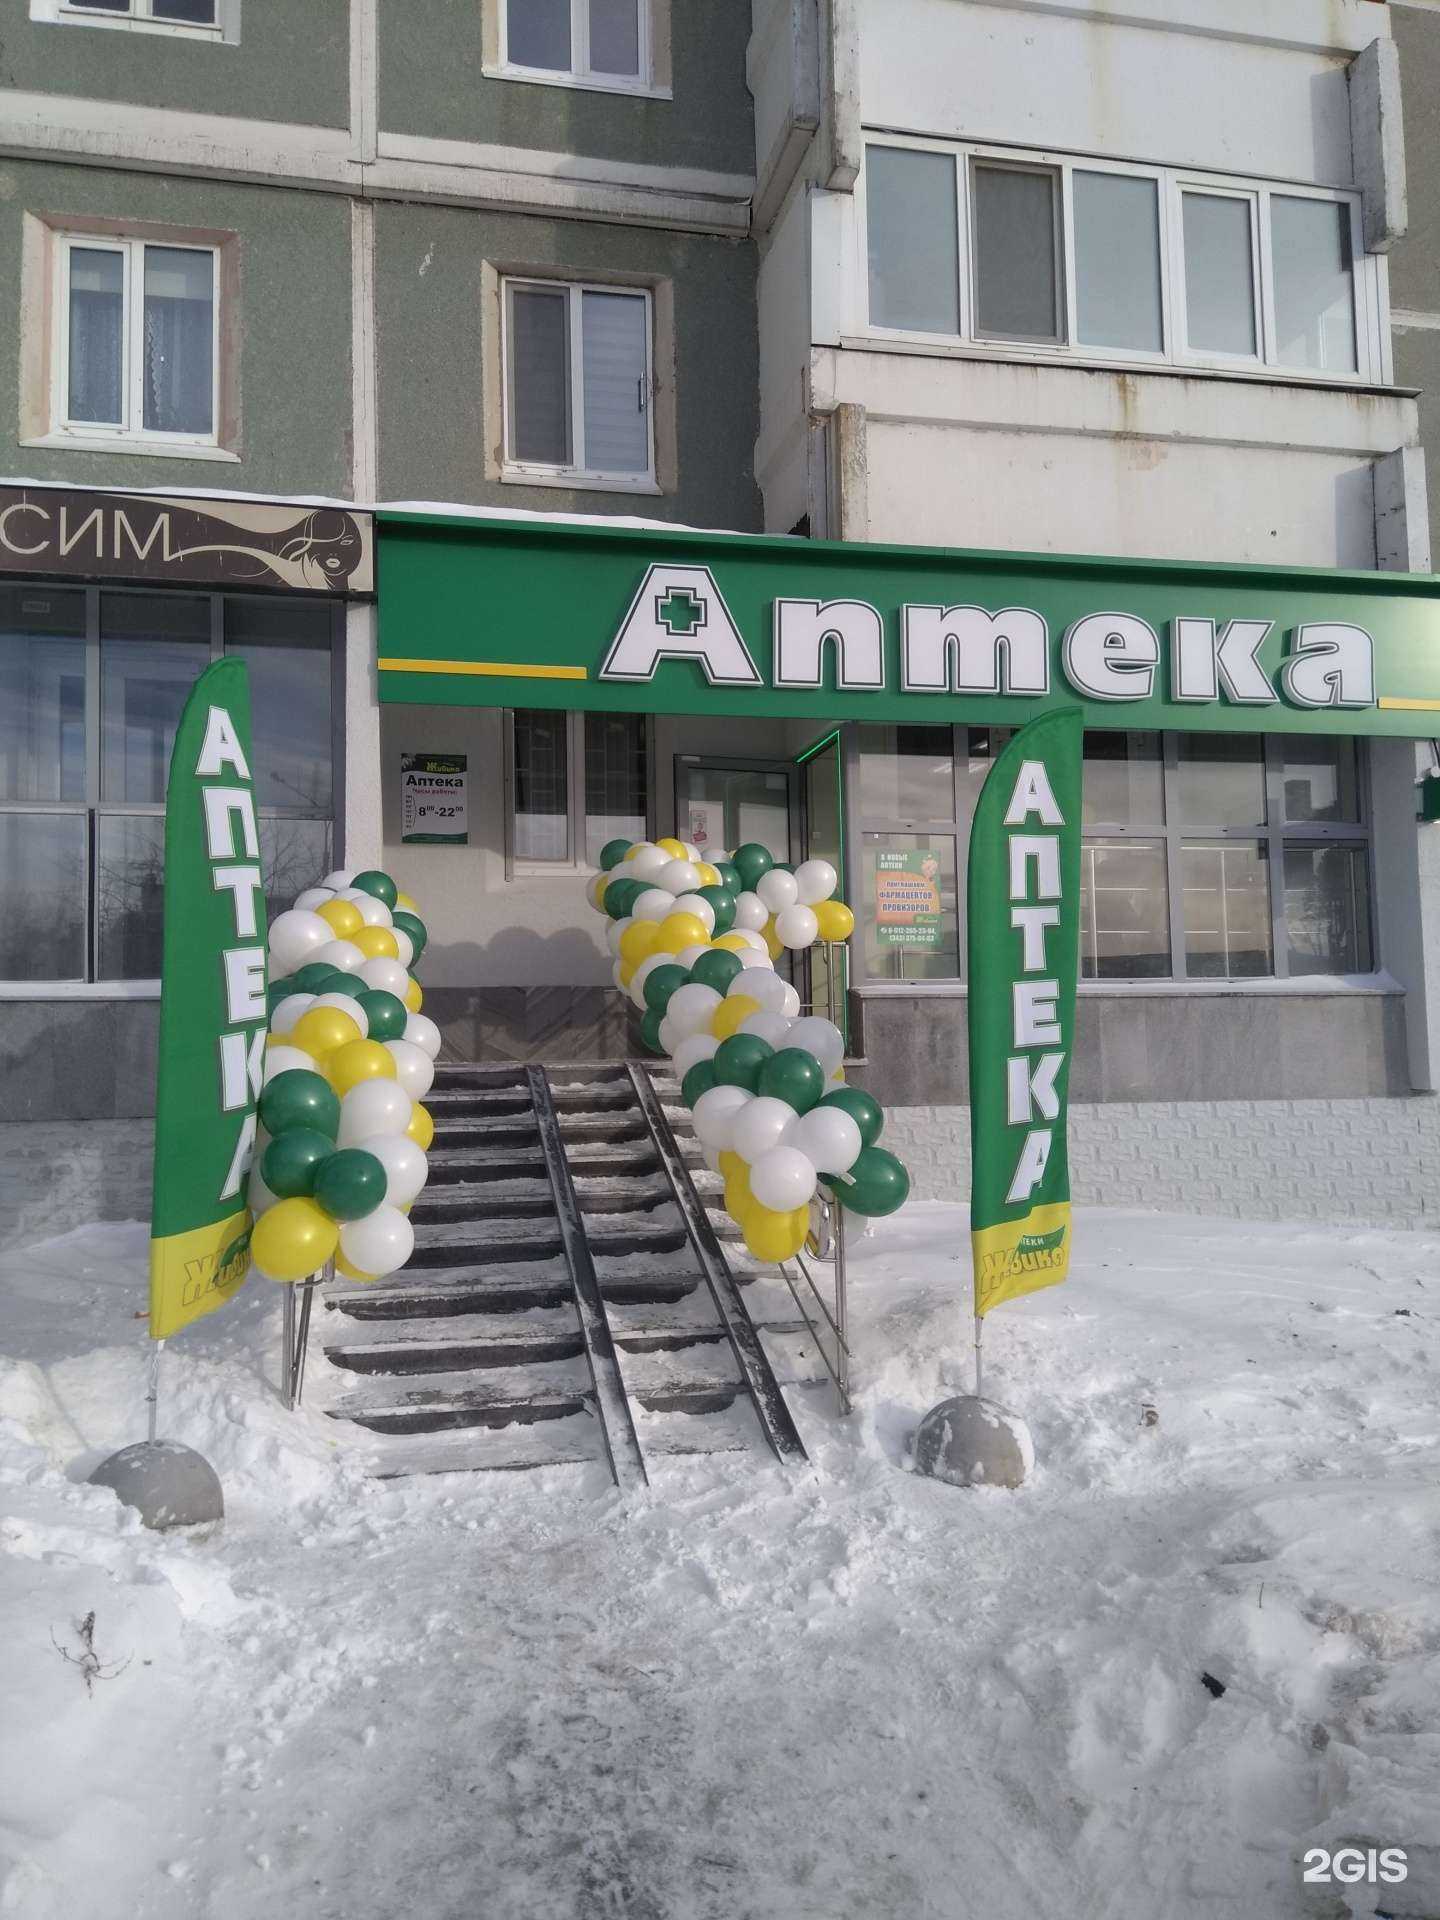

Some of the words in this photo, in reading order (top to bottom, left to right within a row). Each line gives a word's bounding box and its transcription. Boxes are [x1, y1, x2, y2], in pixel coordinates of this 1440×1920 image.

[598, 562, 1377, 709] Аптека
[405, 774, 464, 787] Аптека
[1003, 758, 1066, 1205] АПТЕКА
